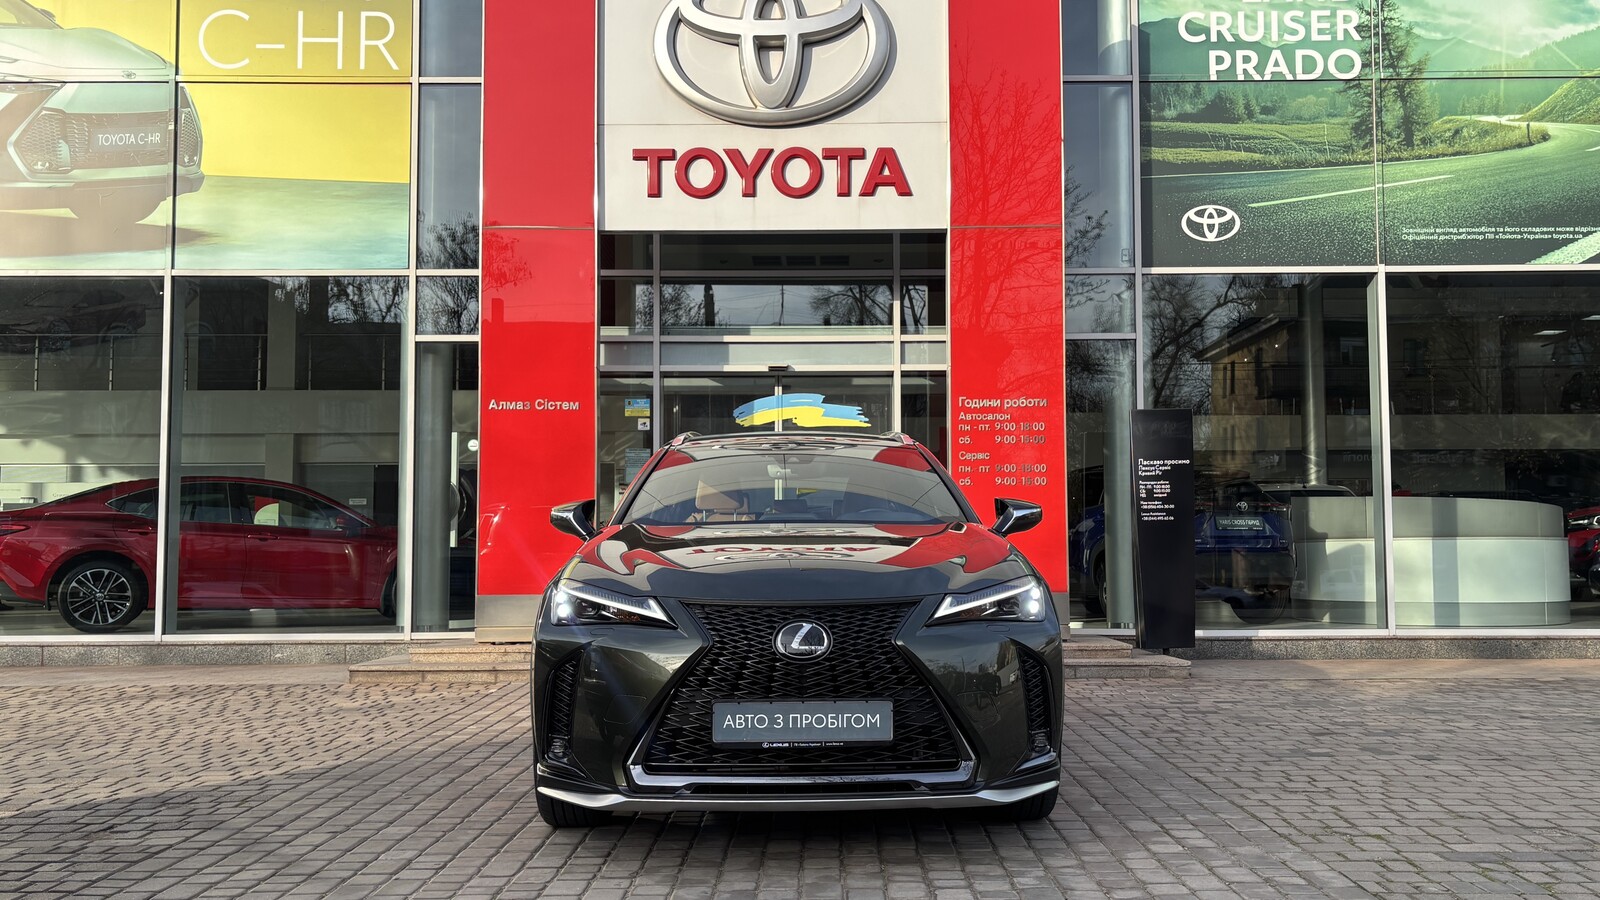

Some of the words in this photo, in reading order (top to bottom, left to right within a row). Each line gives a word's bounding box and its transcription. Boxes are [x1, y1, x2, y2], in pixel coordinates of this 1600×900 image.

[1177, 9, 1363, 43] CRUISER
[198, 9, 400, 70] C-HR
[1208, 48, 1363, 81] PRADO
[97, 133, 136, 146] TOYOTA
[137, 132, 161, 145] C-HR
[632, 146, 914, 199] TOYOTA
[1459, 225, 1496, 233] автомобіля
[1504, 225, 1520, 234] його
[1520, 226, 1555, 234] складових
[1402, 233, 1438, 241] Офіційний
[1552, 233, 1583, 241] toyota.ua
[488, 399, 532, 411] Алмаз
[534, 398, 580, 411] Сістем
[958, 396, 1001, 410] Години
[1004, 396, 1048, 410] роботи
[958, 411, 1011, 421] Автосалон
[958, 436, 973, 445] сб.
[958, 451, 990, 462] Сервіс
[958, 477, 974, 486] сб.
[723, 714, 769, 729] АВТО
[773, 714, 784, 729] З
[789, 713, 881, 728] ПРОБІГОМ
